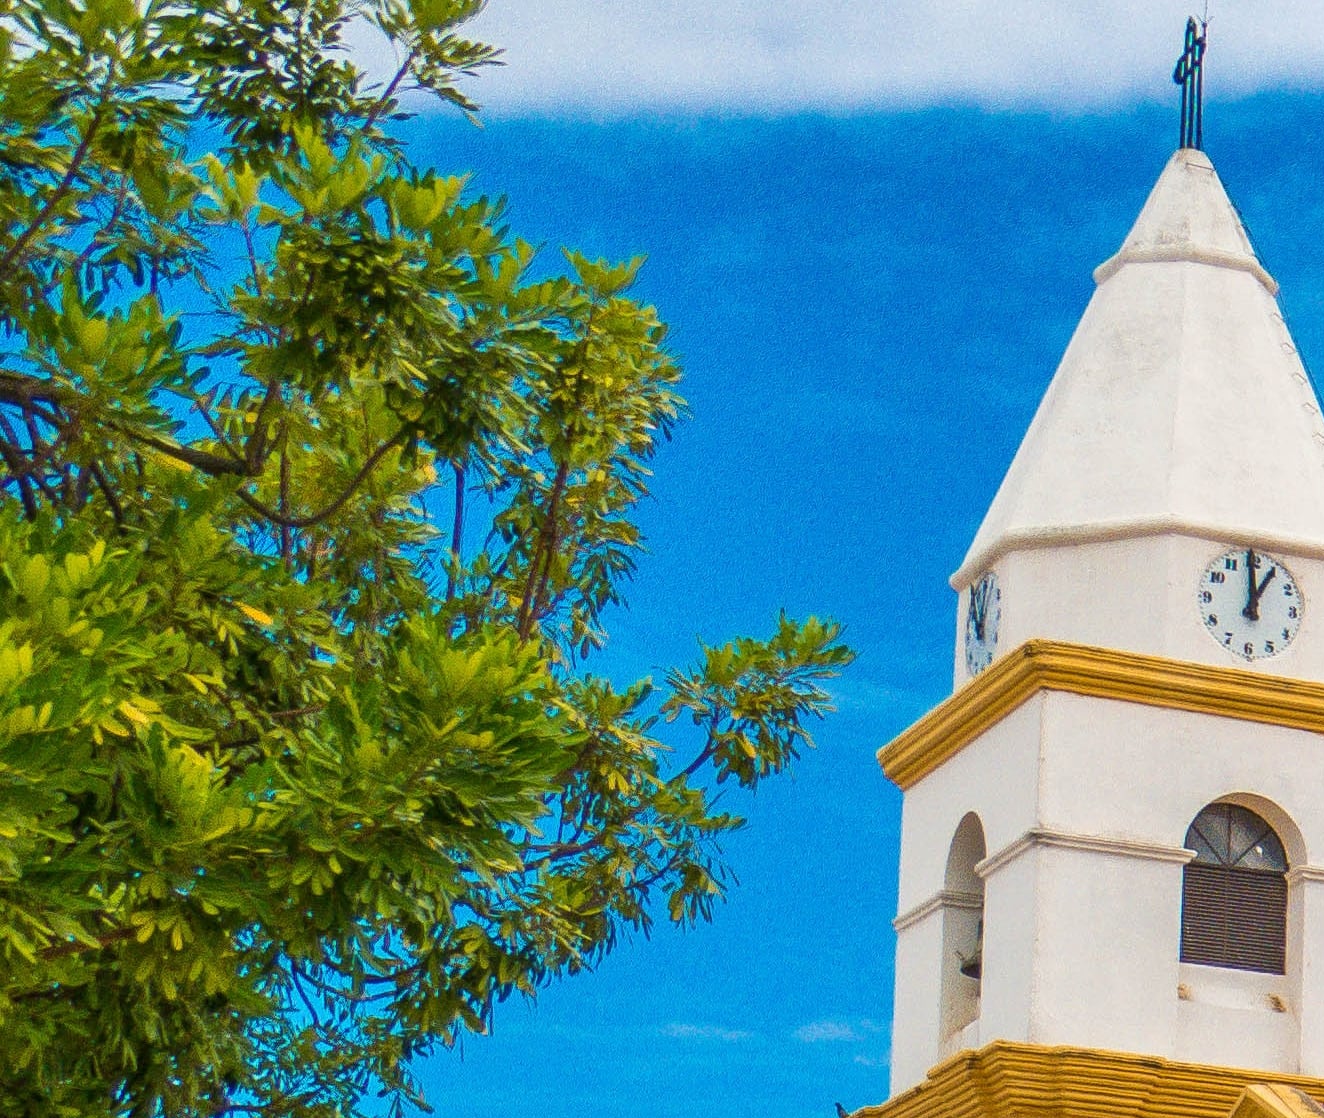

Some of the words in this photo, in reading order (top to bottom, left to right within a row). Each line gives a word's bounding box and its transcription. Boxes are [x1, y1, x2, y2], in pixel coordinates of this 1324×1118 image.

[1210, 572, 1225, 584] 10
[1283, 584, 1292, 596] 2
[1202, 591, 1212, 603] 9
[1289, 606, 1297, 619] 3
[1245, 642, 1253, 655] 6
[1264, 640, 1274, 653] 5
